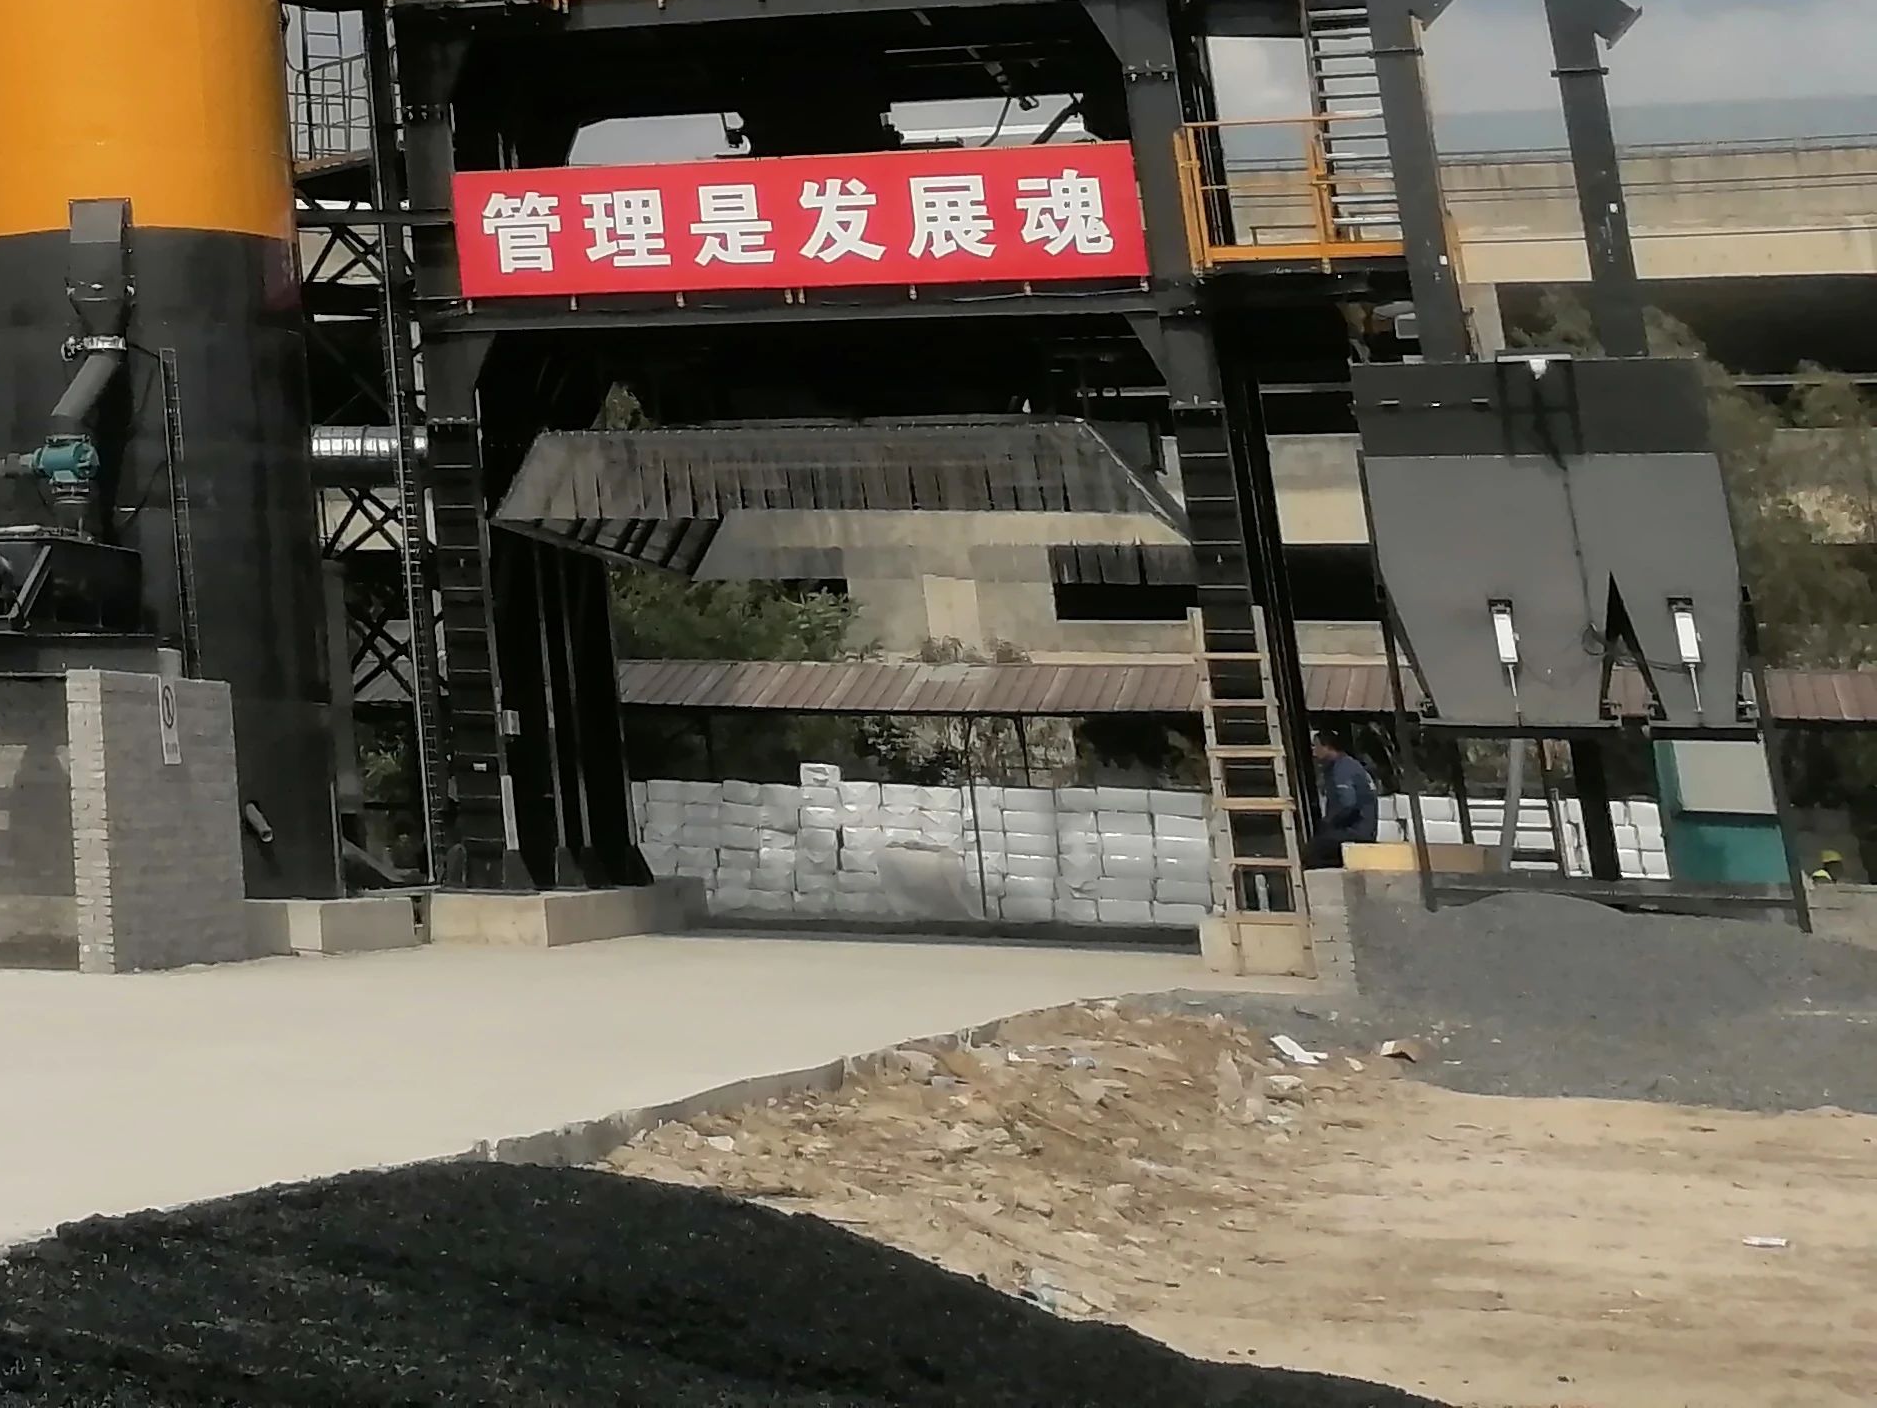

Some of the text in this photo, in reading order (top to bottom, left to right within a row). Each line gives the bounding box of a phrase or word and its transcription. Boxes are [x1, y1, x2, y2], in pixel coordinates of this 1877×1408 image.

[481, 168, 1115, 273] 管理是发展魂
